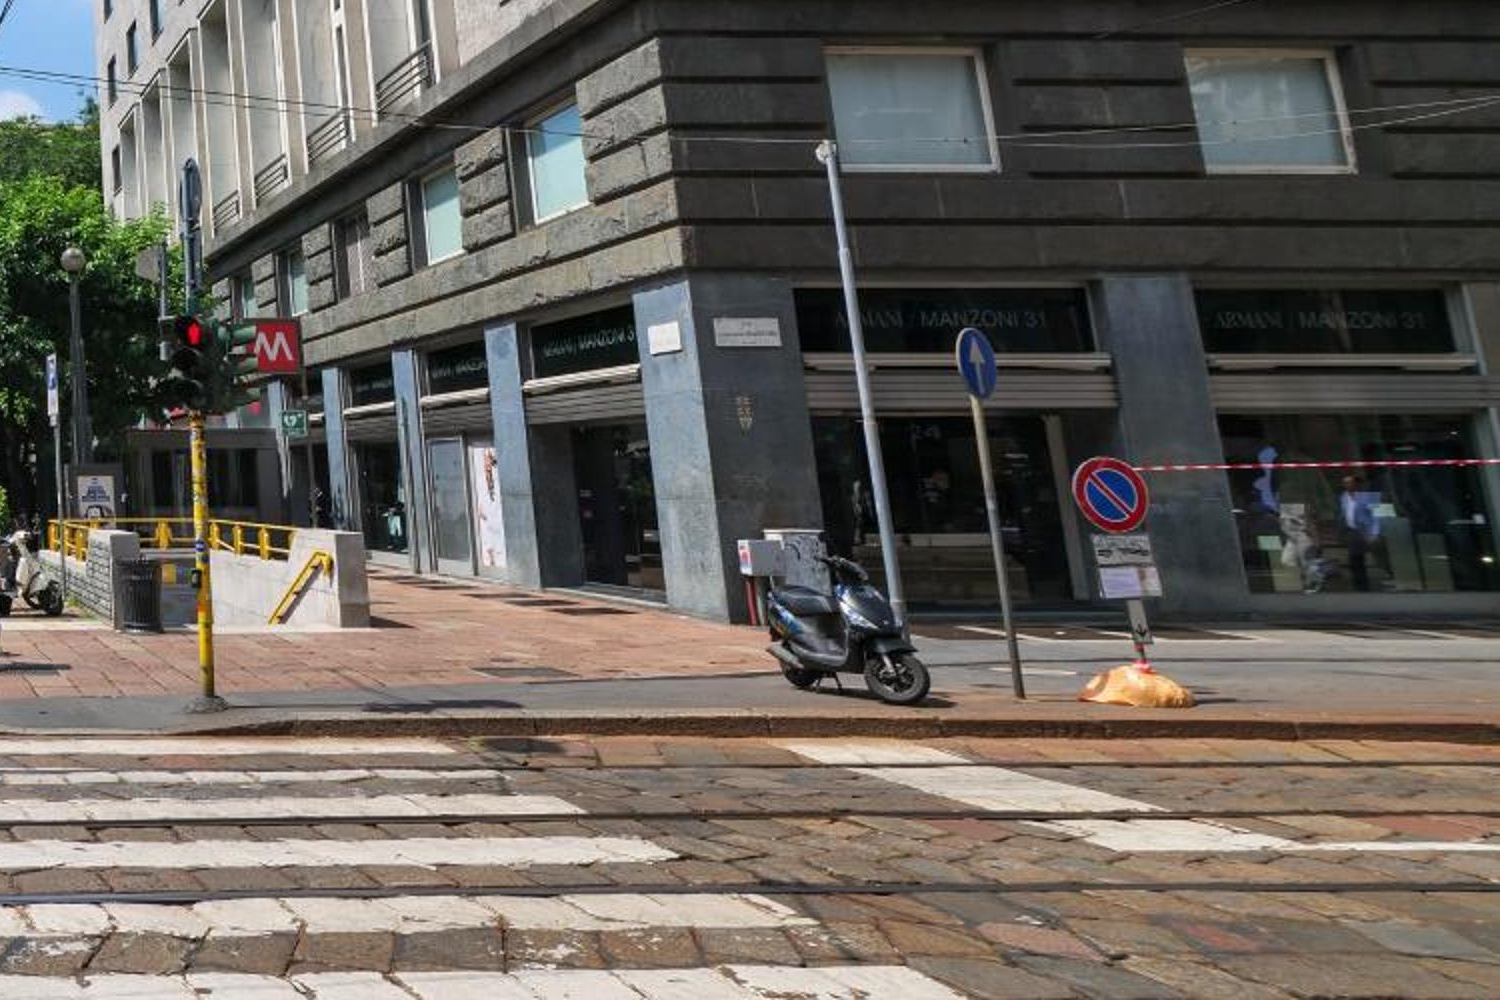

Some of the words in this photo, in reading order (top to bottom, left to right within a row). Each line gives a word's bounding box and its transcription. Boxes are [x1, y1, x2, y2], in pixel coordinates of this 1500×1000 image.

[920, 310, 1017, 329] MANZONI
[1023, 310, 1045, 329] 31
[1215, 311, 1283, 329] ARMANI
[1298, 311, 1397, 329] MANZONI
[1400, 311, 1426, 329] 31
[254, 332, 293, 361] M
